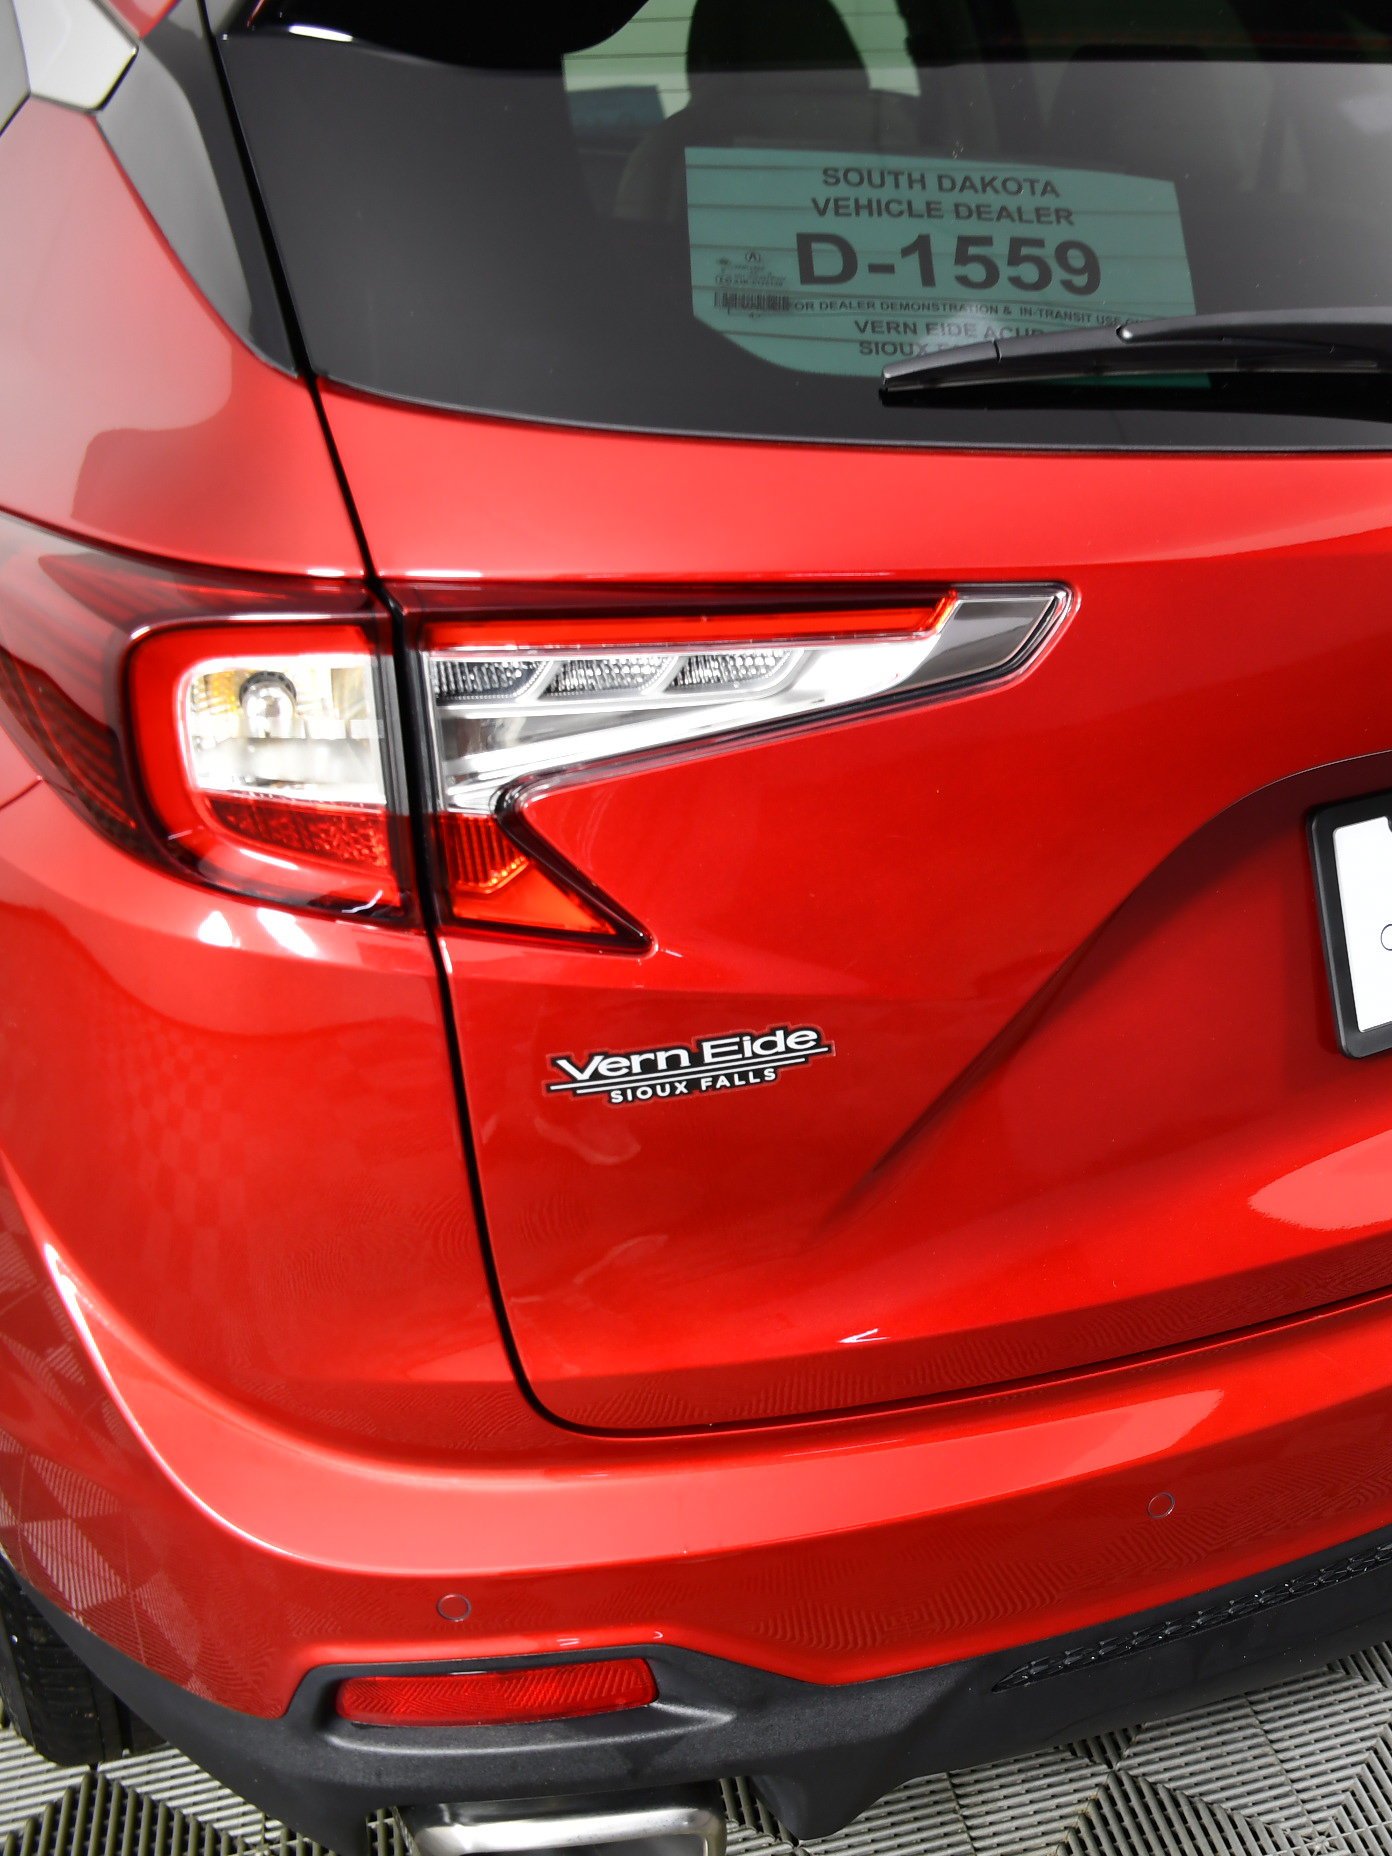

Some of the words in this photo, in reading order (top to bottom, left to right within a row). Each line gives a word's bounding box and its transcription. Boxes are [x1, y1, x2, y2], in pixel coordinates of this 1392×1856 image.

[822, 167, 926, 190] SOUTH
[937, 173, 1061, 198] DAKOTA
[811, 197, 944, 220] VEHICLE
[954, 203, 1075, 226] DEALER
[795, 232, 1101, 296] D-1559
[819, 301, 876, 311] DEALER
[880, 301, 999, 315] DEMONSTRATION
[1002, 304, 1013, 315] &
[854, 319, 918, 336] VERN
[925, 321, 977, 338] EIDE
[983, 324, 1044, 338] ACUR
[555, 1048, 691, 1081] Vern
[702, 1029, 818, 1064] Eide
[610, 1081, 689, 1103] SIOUX
[701, 1068, 776, 1091] FALLS
